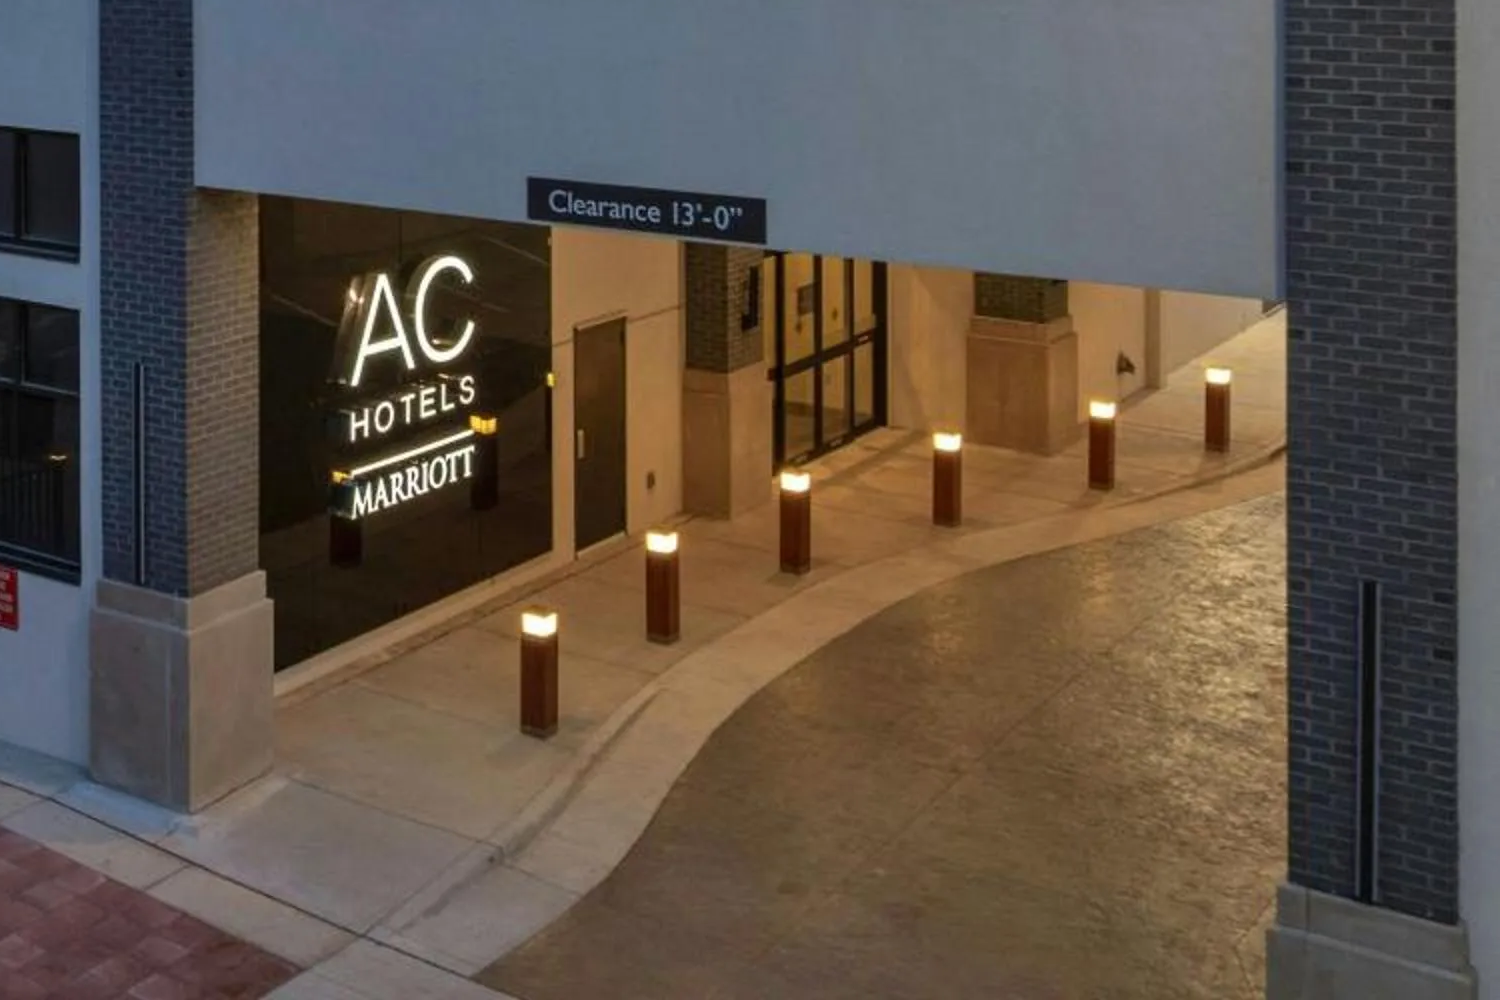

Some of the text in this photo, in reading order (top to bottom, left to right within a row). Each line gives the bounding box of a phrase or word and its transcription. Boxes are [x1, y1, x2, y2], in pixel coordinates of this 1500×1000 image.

[548, 189, 661, 223] Clearance
[350, 255, 476, 387] AC
[350, 375, 476, 442] HOTELS
[350, 445, 476, 521] MARRIOTT
